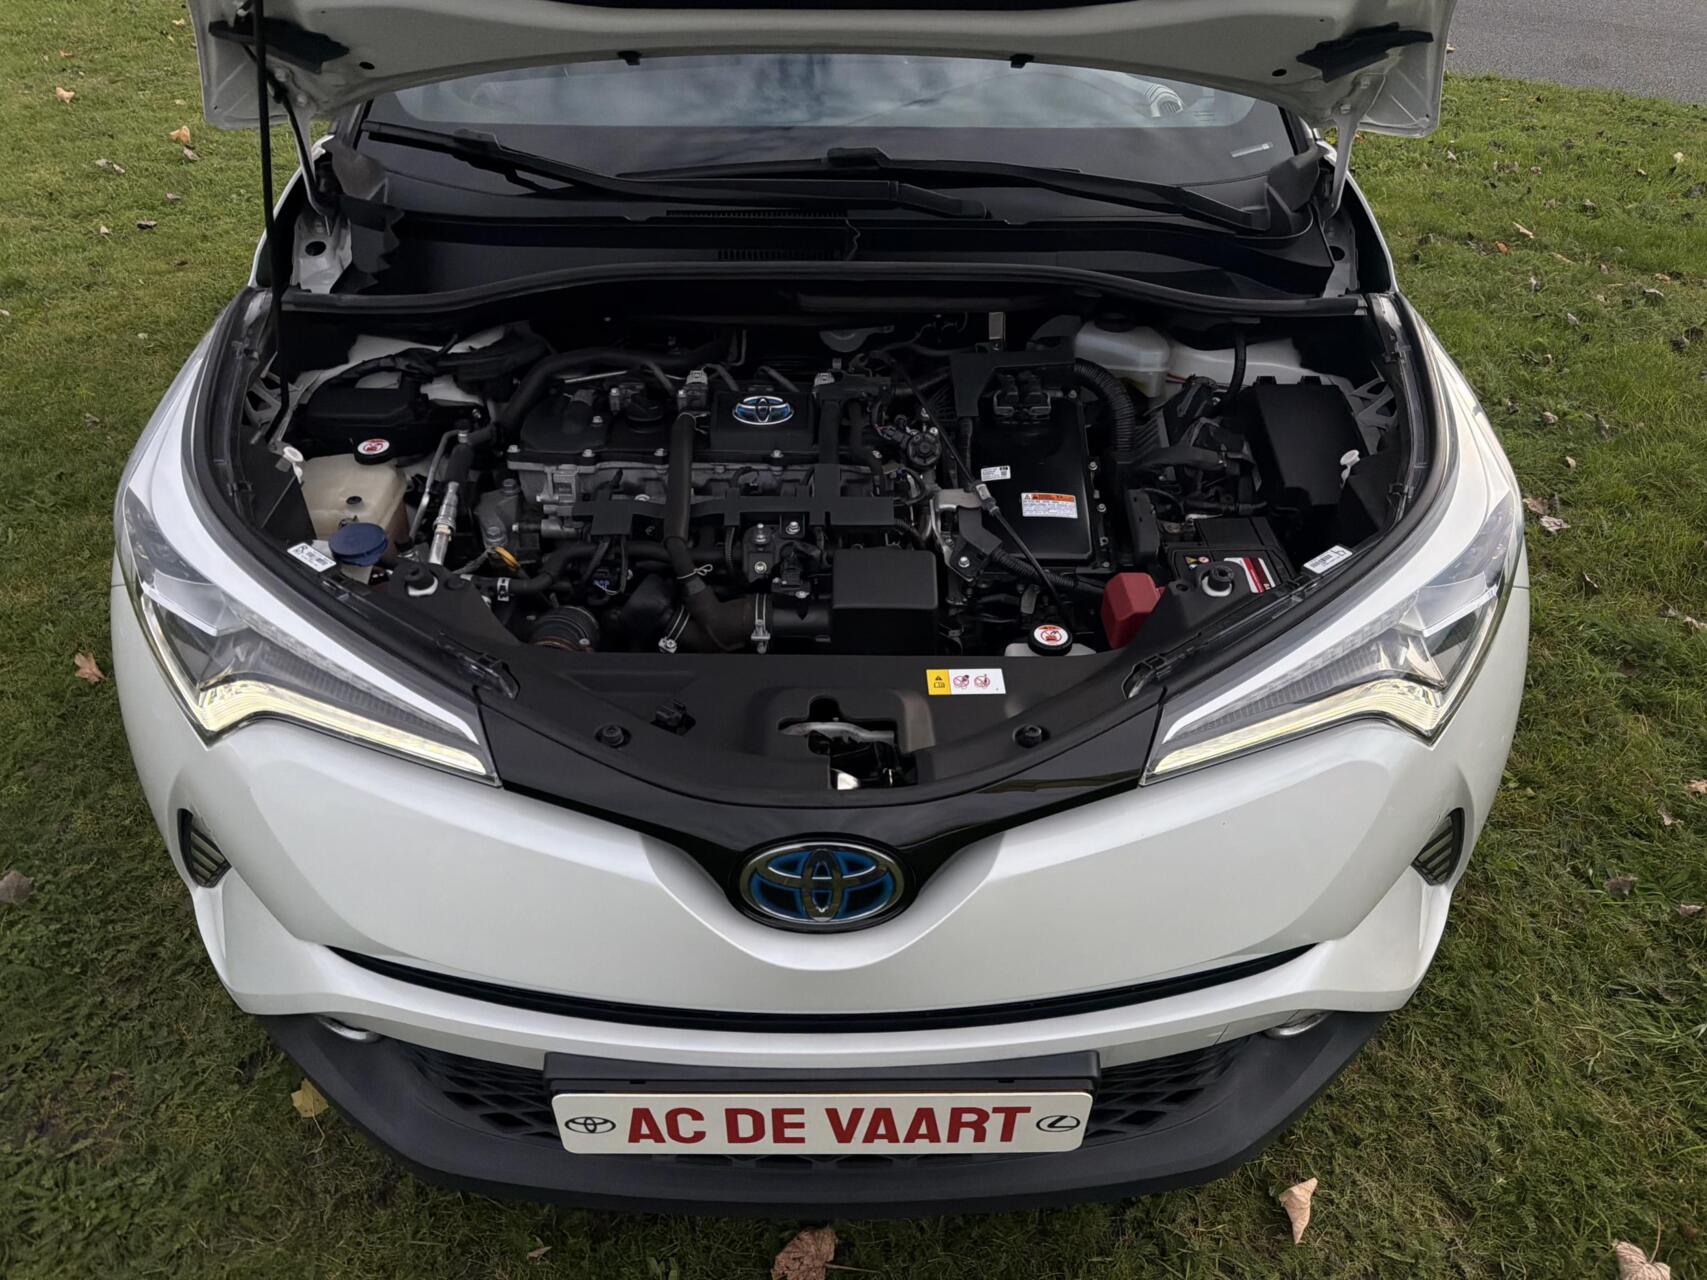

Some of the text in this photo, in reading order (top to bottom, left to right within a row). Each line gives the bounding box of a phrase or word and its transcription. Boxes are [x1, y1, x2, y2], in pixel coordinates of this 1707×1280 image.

[628, 1107, 1029, 1143] AC DE VAART
